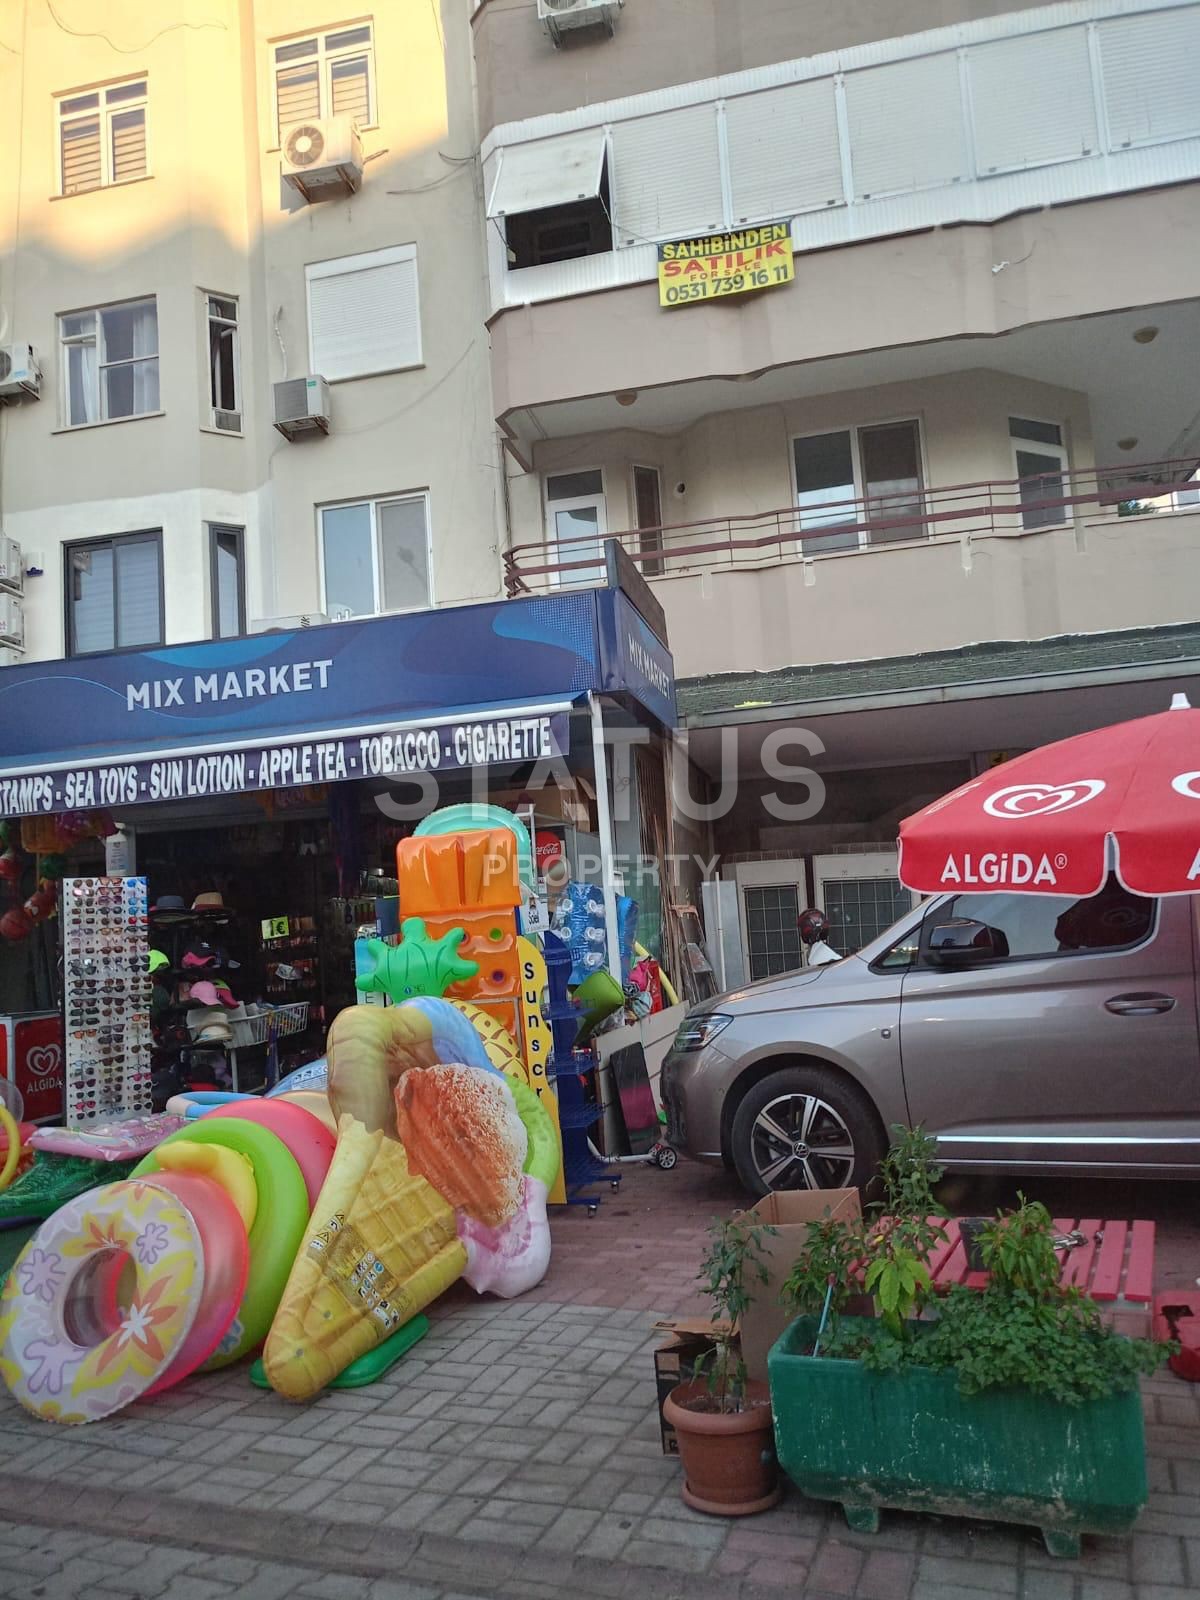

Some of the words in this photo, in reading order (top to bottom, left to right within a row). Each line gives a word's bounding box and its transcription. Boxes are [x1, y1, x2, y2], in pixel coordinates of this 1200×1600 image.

[664, 240, 786, 277] SATILIK
[690, 271, 718, 281] FOR
[724, 261, 761, 275] SALE
[666, 282, 707, 303] 0531
[712, 273, 745, 295] 739
[750, 269, 769, 286] 16
[773, 263, 788, 282] 11
[127, 677, 185, 711] MIX
[194, 659, 333, 703] MARKET
[627, 632, 644, 675] MIX
[643, 650, 671, 701] MARKET
[0, 775, 53, 815] TAMPS
[64, 771, 94, 808] SEA
[99, 765, 138, 804] TOYS
[150, 760, 183, 799] SUN
[187, 753, 246, 794] LOTION
[258, 745, 312, 787] APPLE
[316, 741, 348, 780] TEA
[360, 731, 441, 776] TOBACCO
